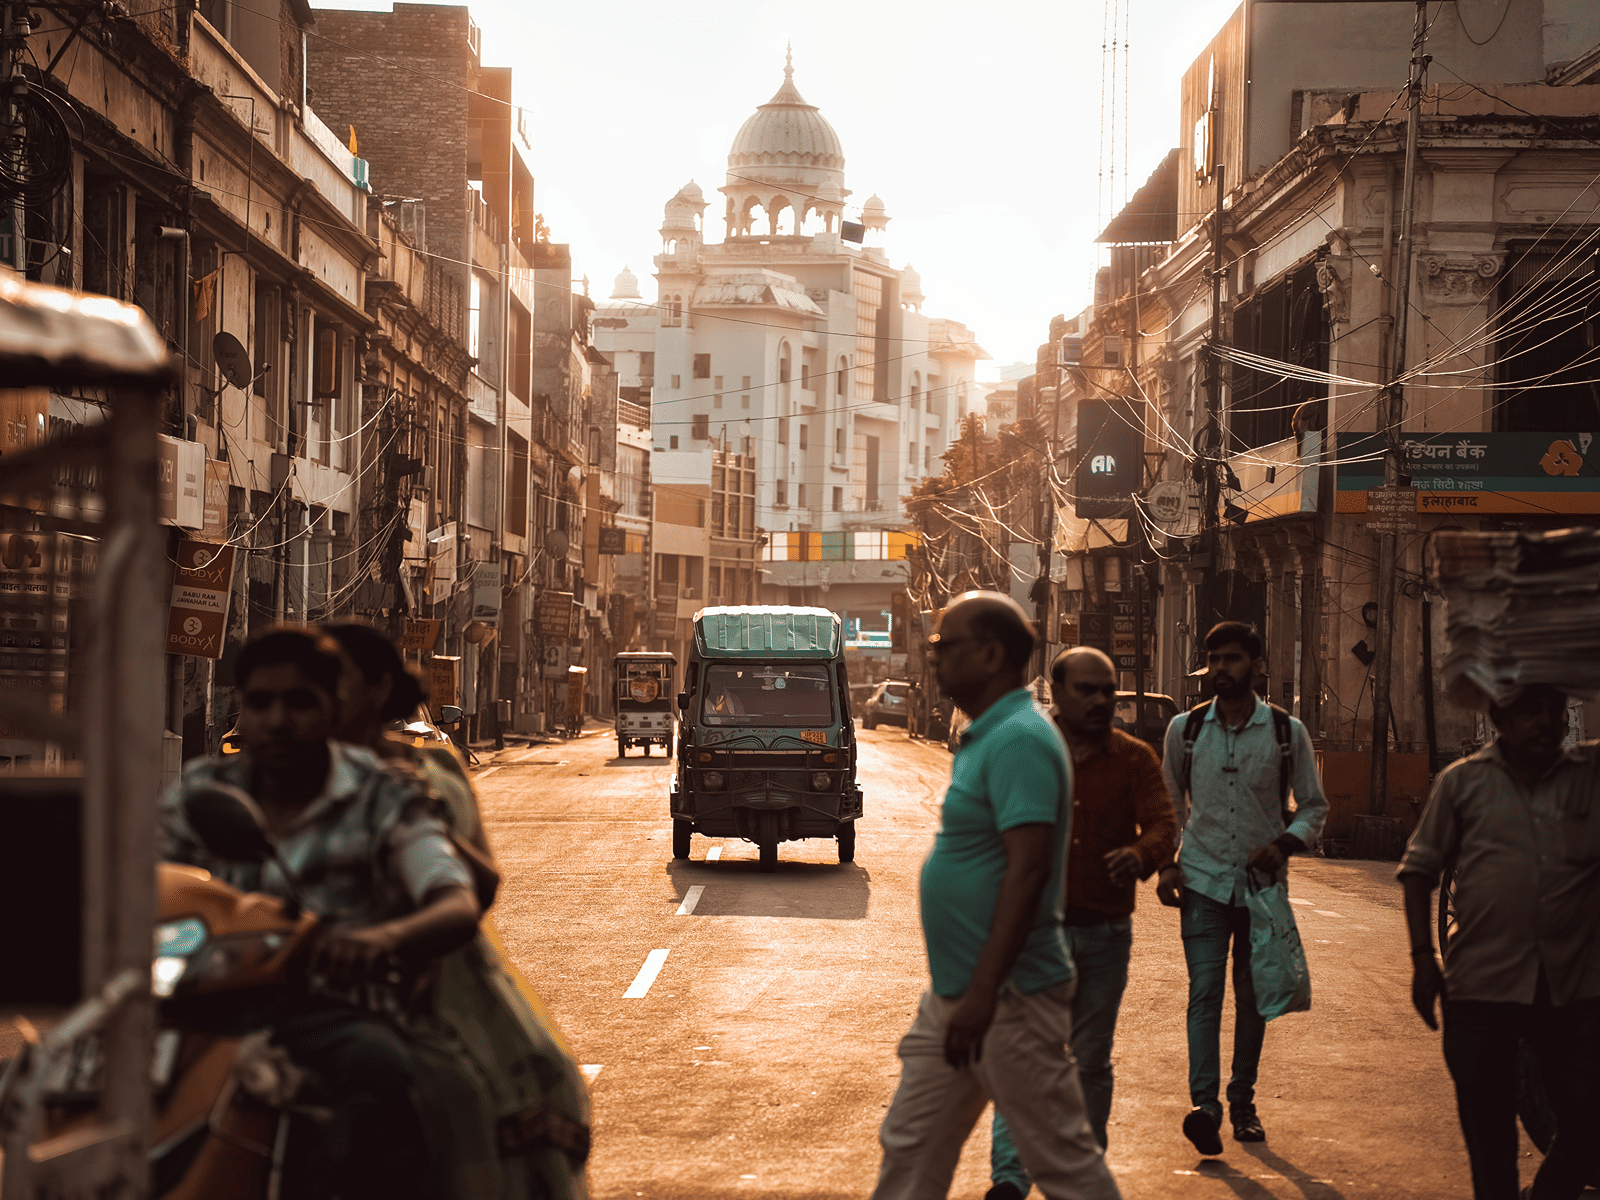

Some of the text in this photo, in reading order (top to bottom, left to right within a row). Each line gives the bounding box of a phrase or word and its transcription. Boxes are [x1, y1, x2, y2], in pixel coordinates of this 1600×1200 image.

[1399, 439, 1488, 459] डियन बैंक
[1432, 477, 1455, 490] सिटी
[1457, 480, 1484, 491] शाखा
[1421, 495, 1479, 508] इलाहाबाद
[182, 590, 201, 598] BABU
[176, 597, 220, 608] JAWAHAR LAL
